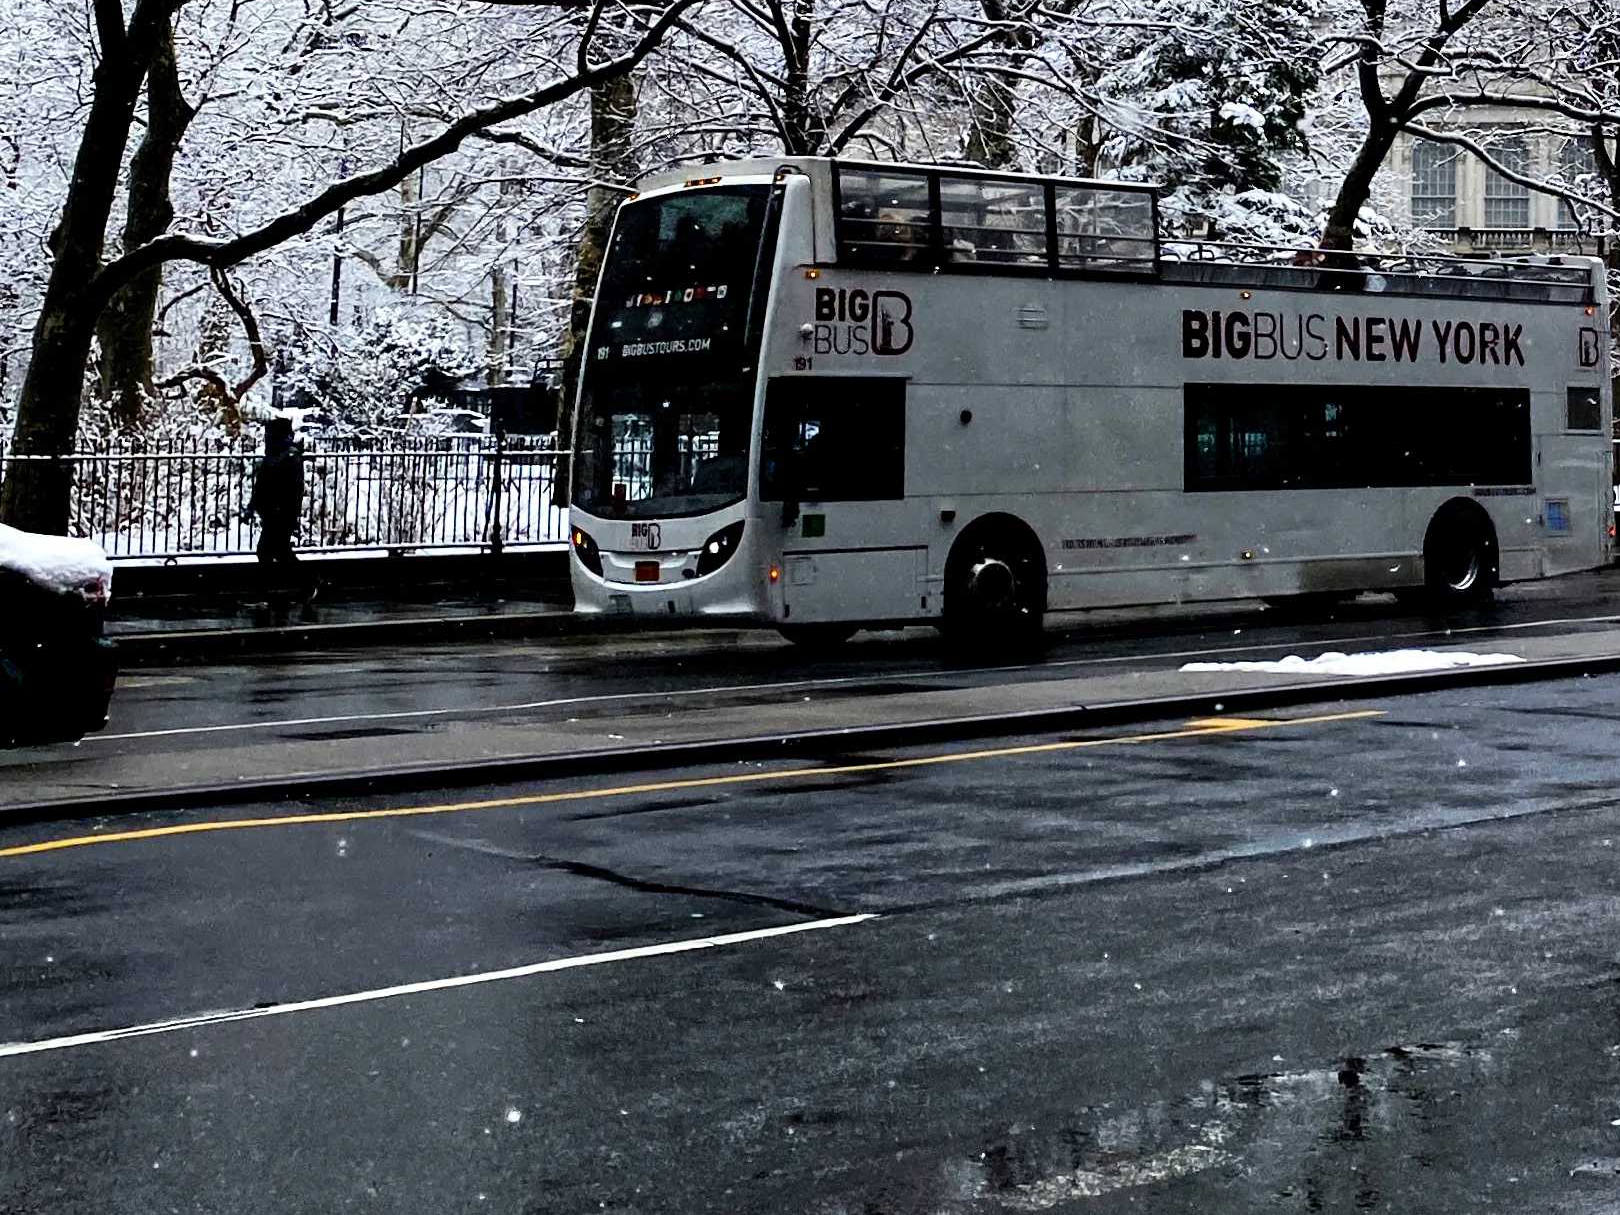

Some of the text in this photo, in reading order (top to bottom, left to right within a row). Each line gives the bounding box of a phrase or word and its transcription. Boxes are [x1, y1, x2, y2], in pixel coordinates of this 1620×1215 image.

[815, 288, 869, 322] BIG
[621, 337, 711, 358] BIGBUSTOURS.COM
[814, 324, 869, 355] BUS
[1335, 316, 1422, 363] NEW
[1431, 320, 1525, 367] YORK
[631, 523, 647, 537] BIG
